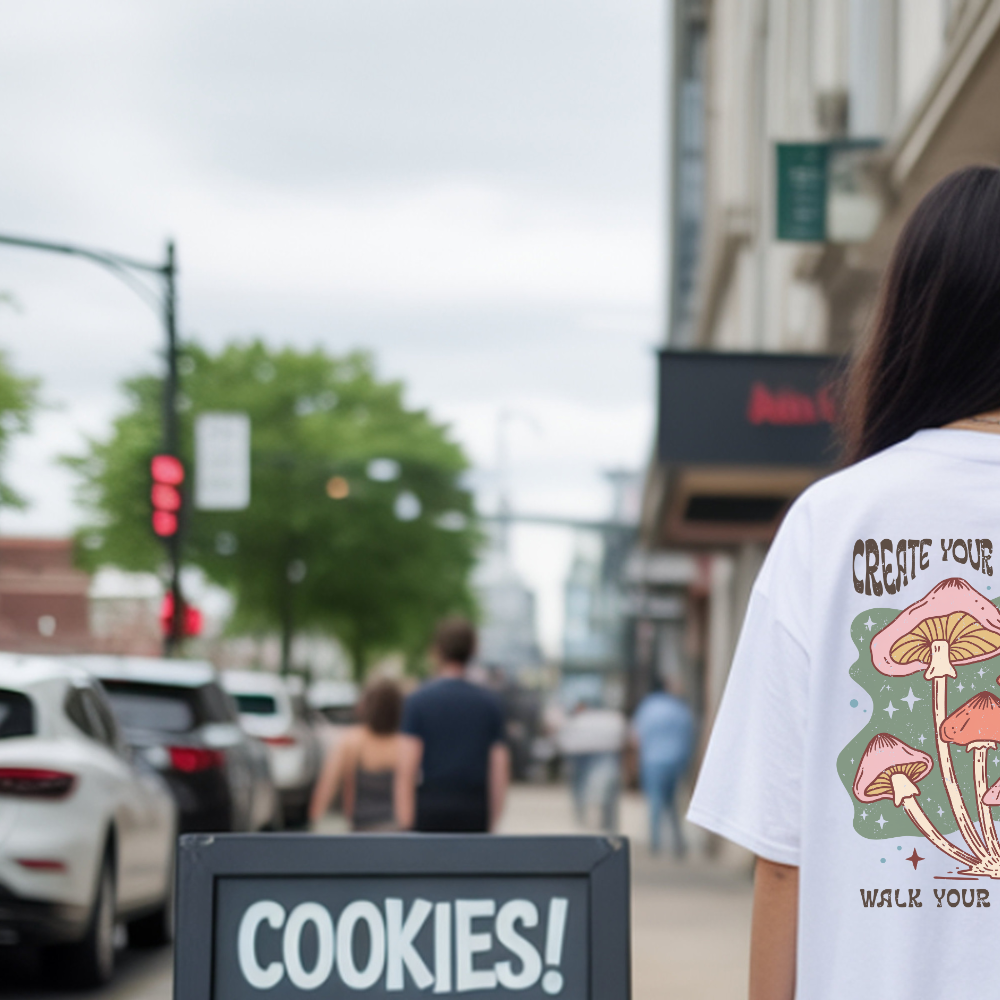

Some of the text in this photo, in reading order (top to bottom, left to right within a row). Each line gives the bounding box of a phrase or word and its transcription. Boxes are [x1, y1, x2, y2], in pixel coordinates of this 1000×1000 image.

[852, 538, 932, 597] CREATE
[940, 538, 994, 576] YOUR
[859, 888, 923, 908] WALK
[933, 888, 991, 908] YOUR
[238, 897, 568, 994] COOKIES!
